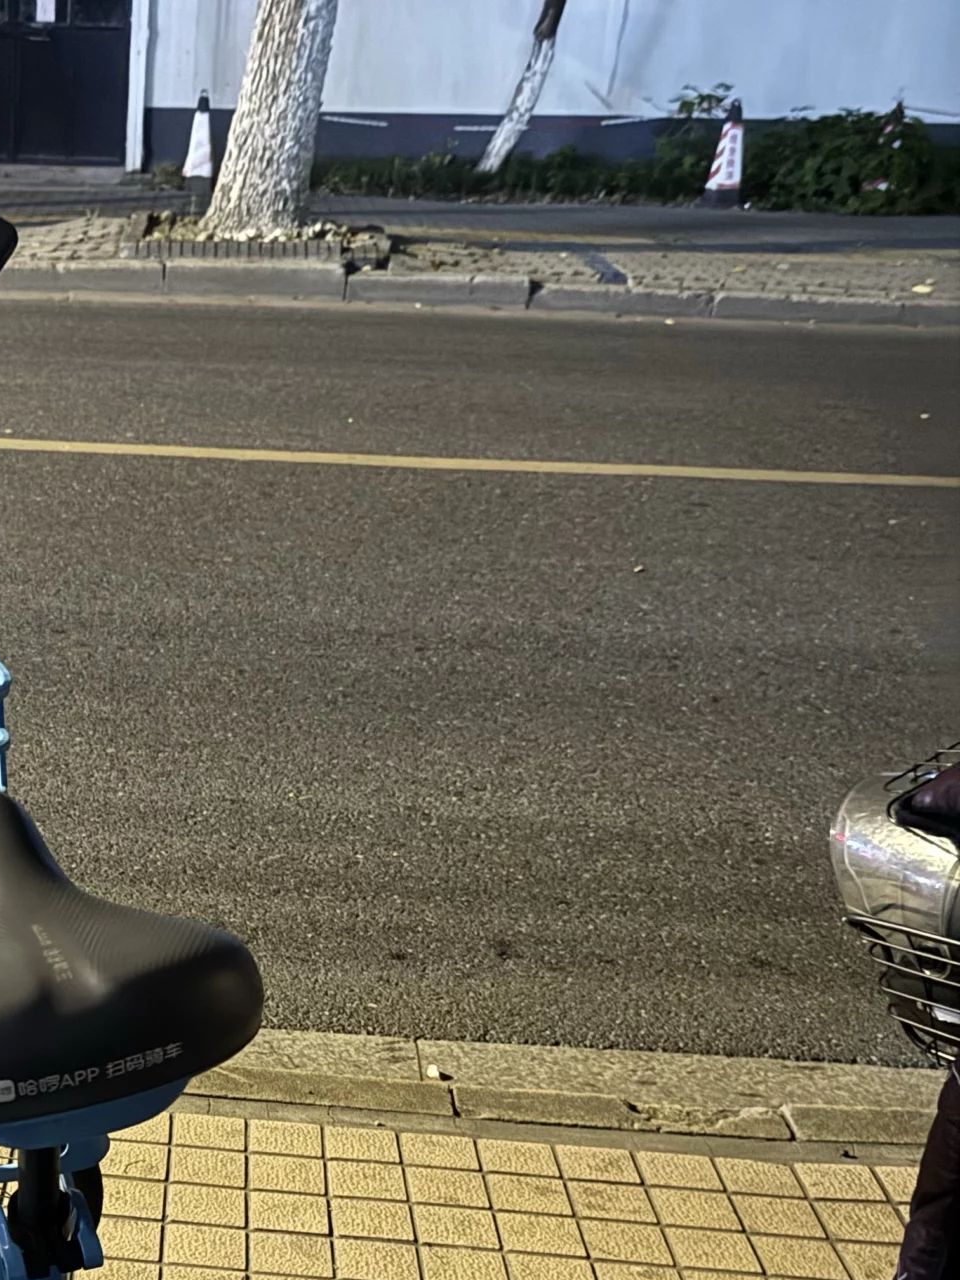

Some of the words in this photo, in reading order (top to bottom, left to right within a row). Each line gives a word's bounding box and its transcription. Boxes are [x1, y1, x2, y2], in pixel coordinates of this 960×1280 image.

[18, 1067, 100, 1096] 哈啰APP
[106, 1042, 183, 1079] 扫码骑车
